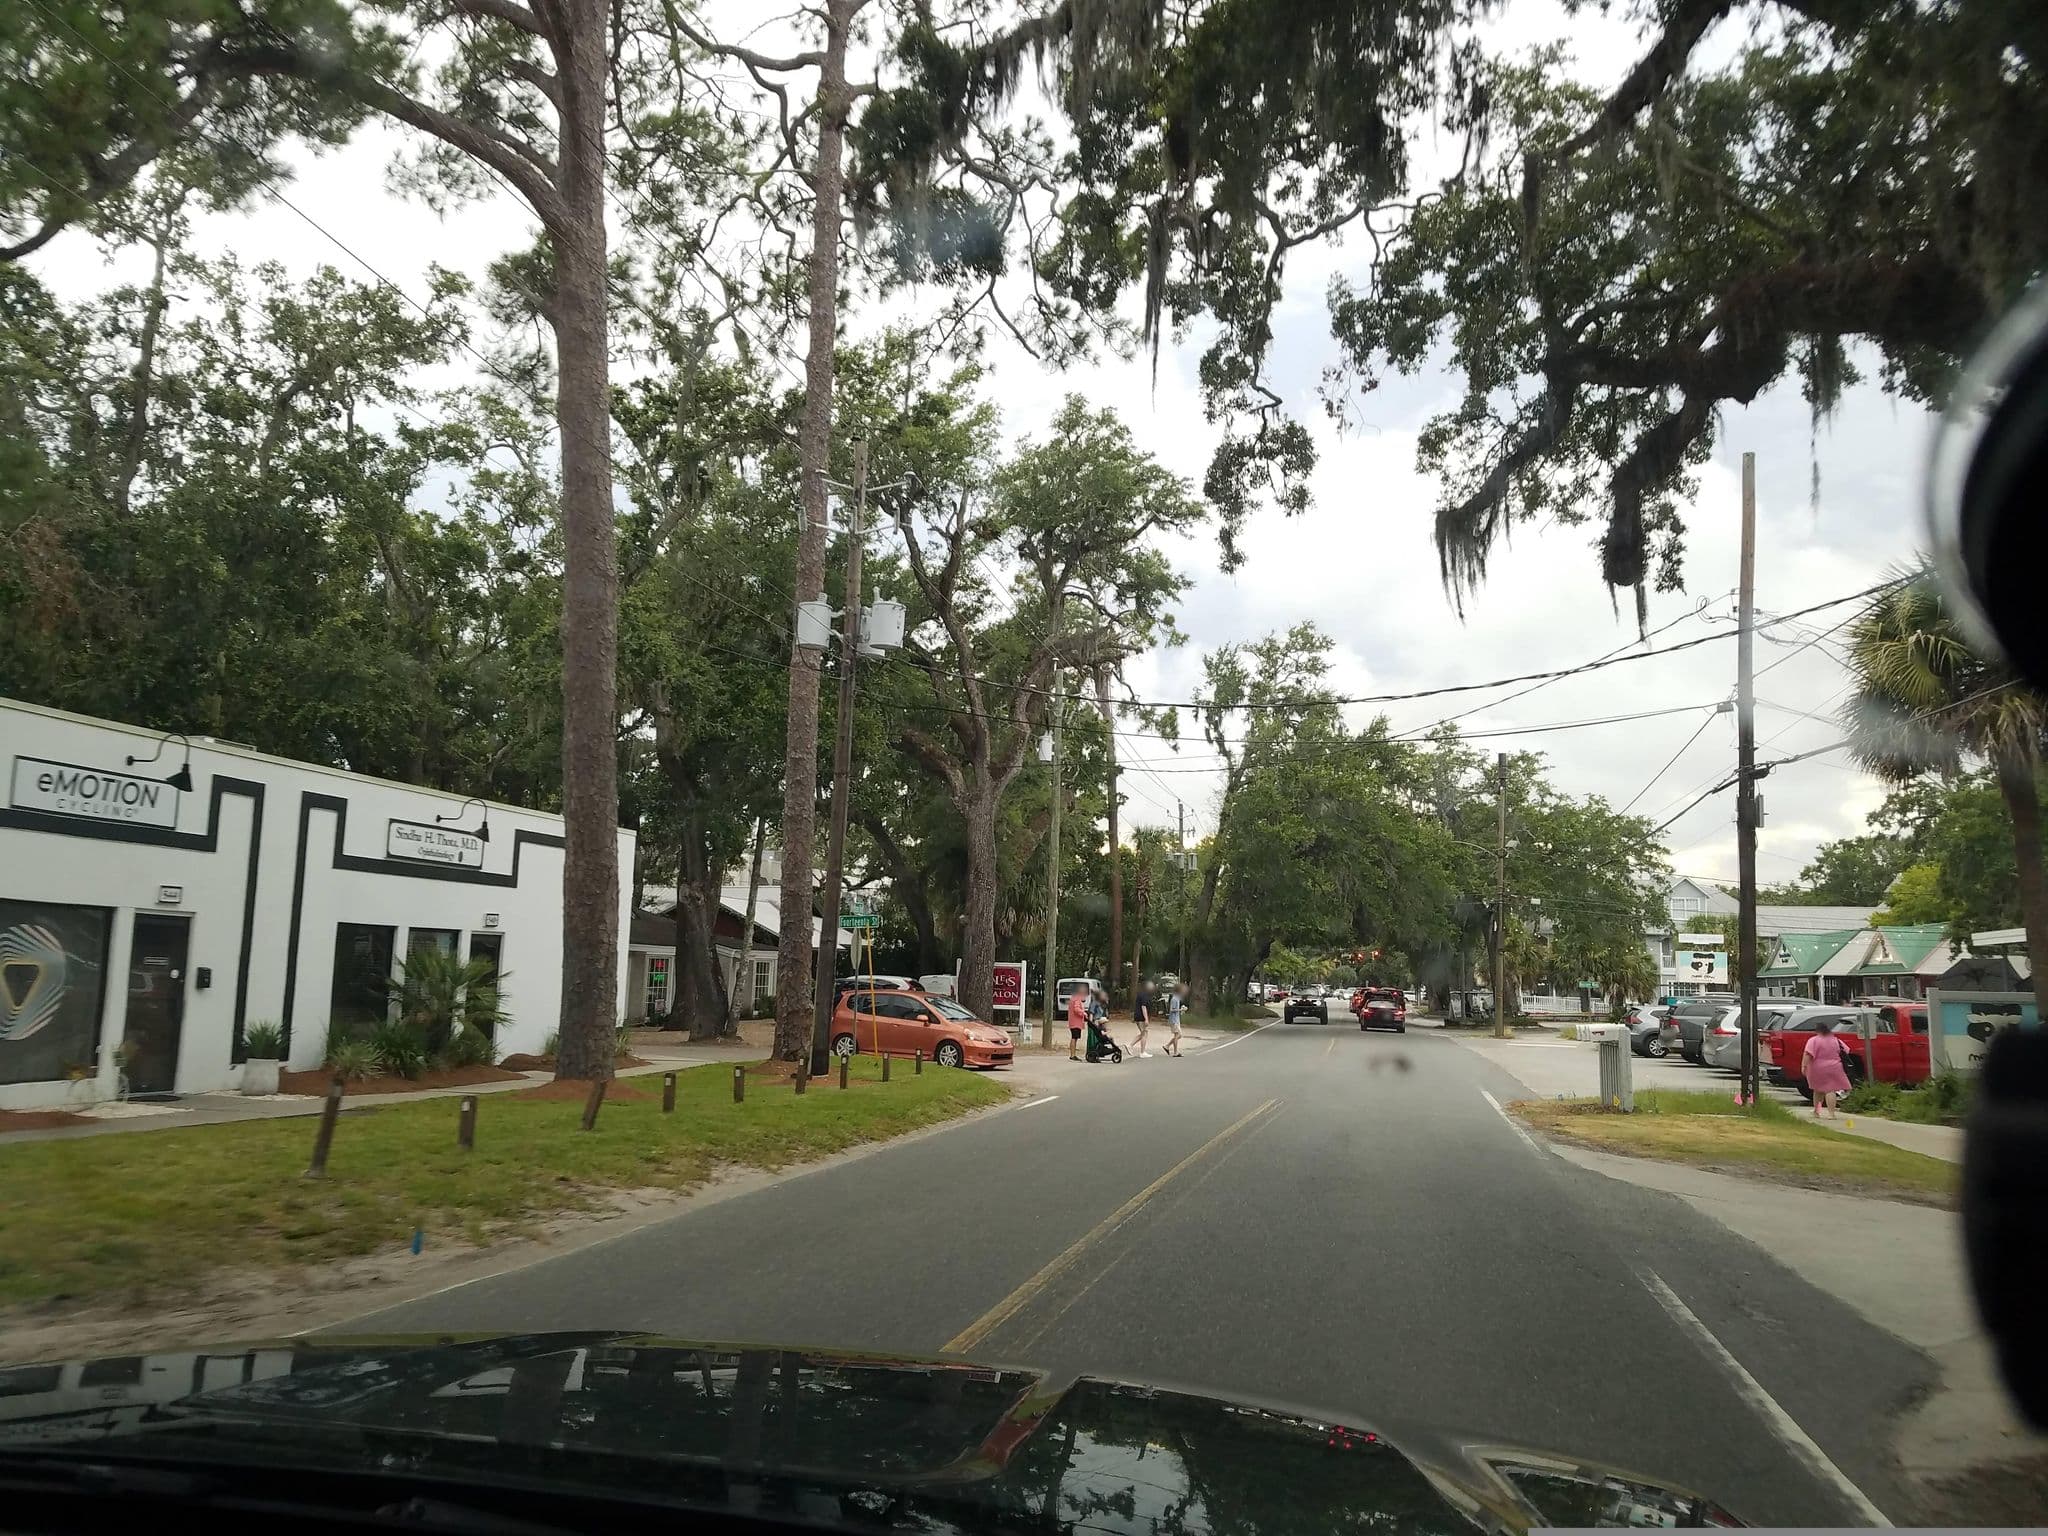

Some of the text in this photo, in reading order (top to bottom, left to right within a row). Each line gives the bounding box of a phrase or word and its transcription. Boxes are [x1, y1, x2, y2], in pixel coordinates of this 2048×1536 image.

[37, 770, 159, 808] eMOTION
[56, 798, 134, 818] CYCLING
[992, 991, 1018, 999] ALON
